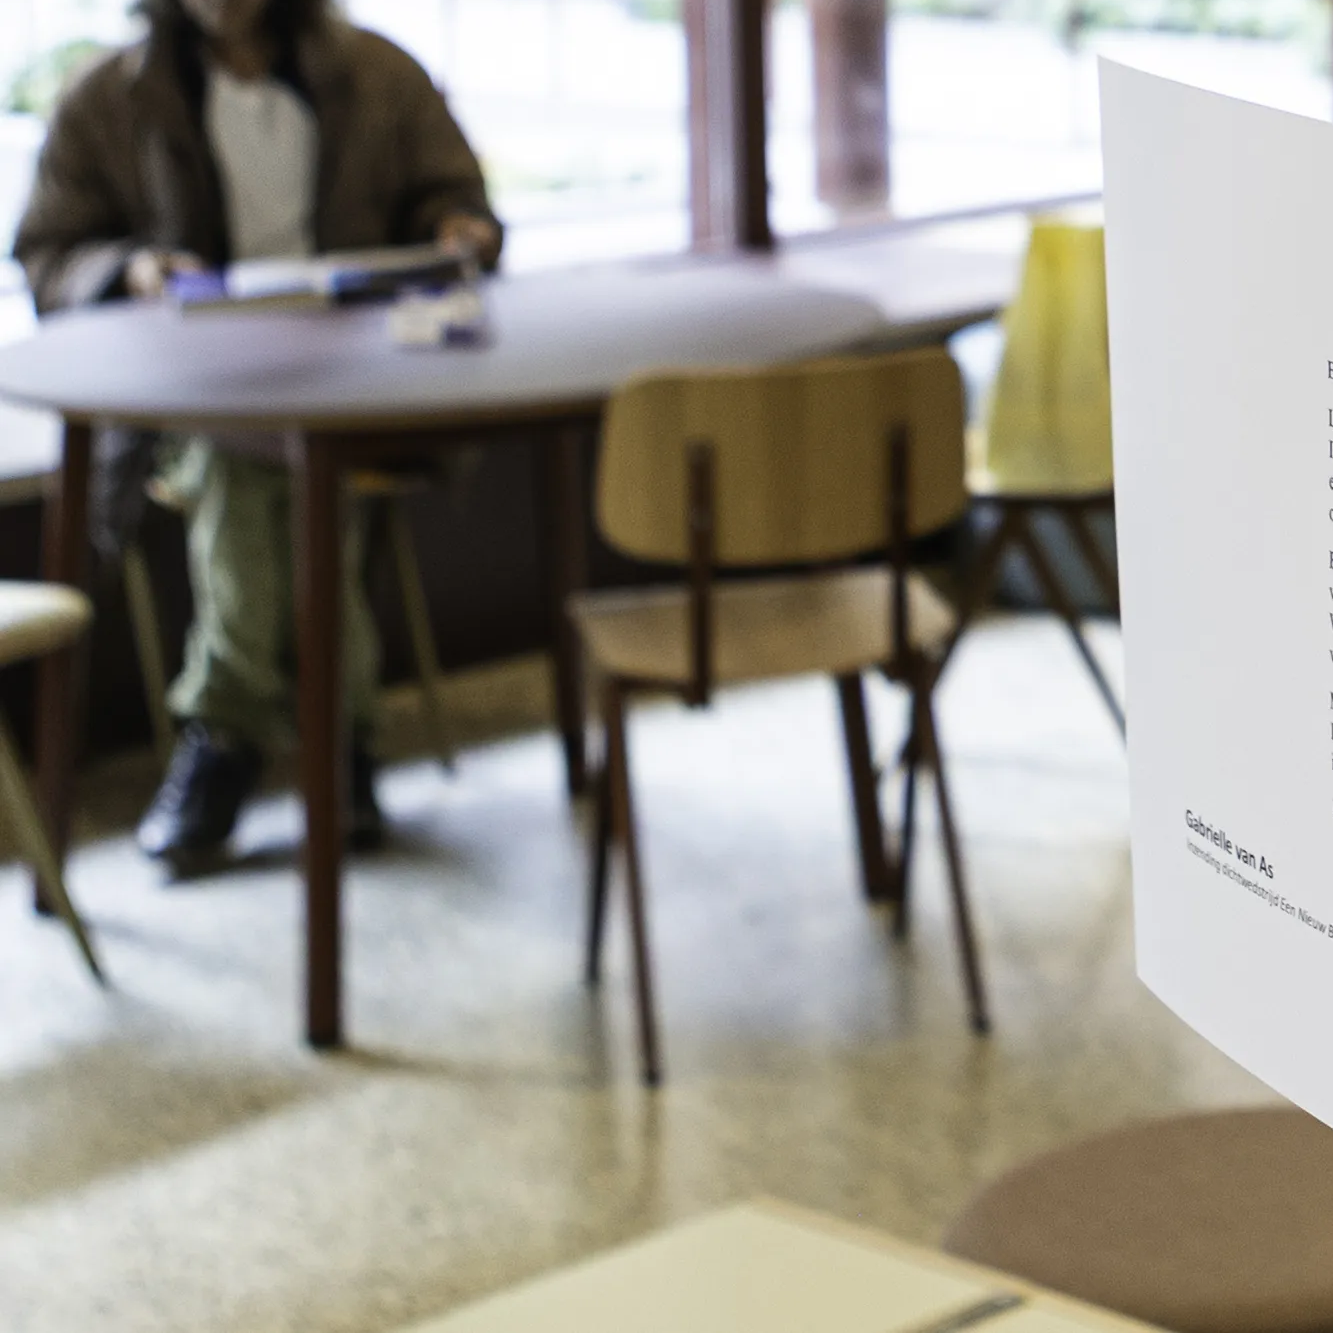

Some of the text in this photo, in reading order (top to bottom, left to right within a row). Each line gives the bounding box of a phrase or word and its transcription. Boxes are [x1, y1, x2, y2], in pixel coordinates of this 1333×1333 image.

[1186, 809, 1274, 879] Gabrielle van As
[1280, 897, 1296, 917] Een
[1298, 907, 1327, 934] Nieuw
